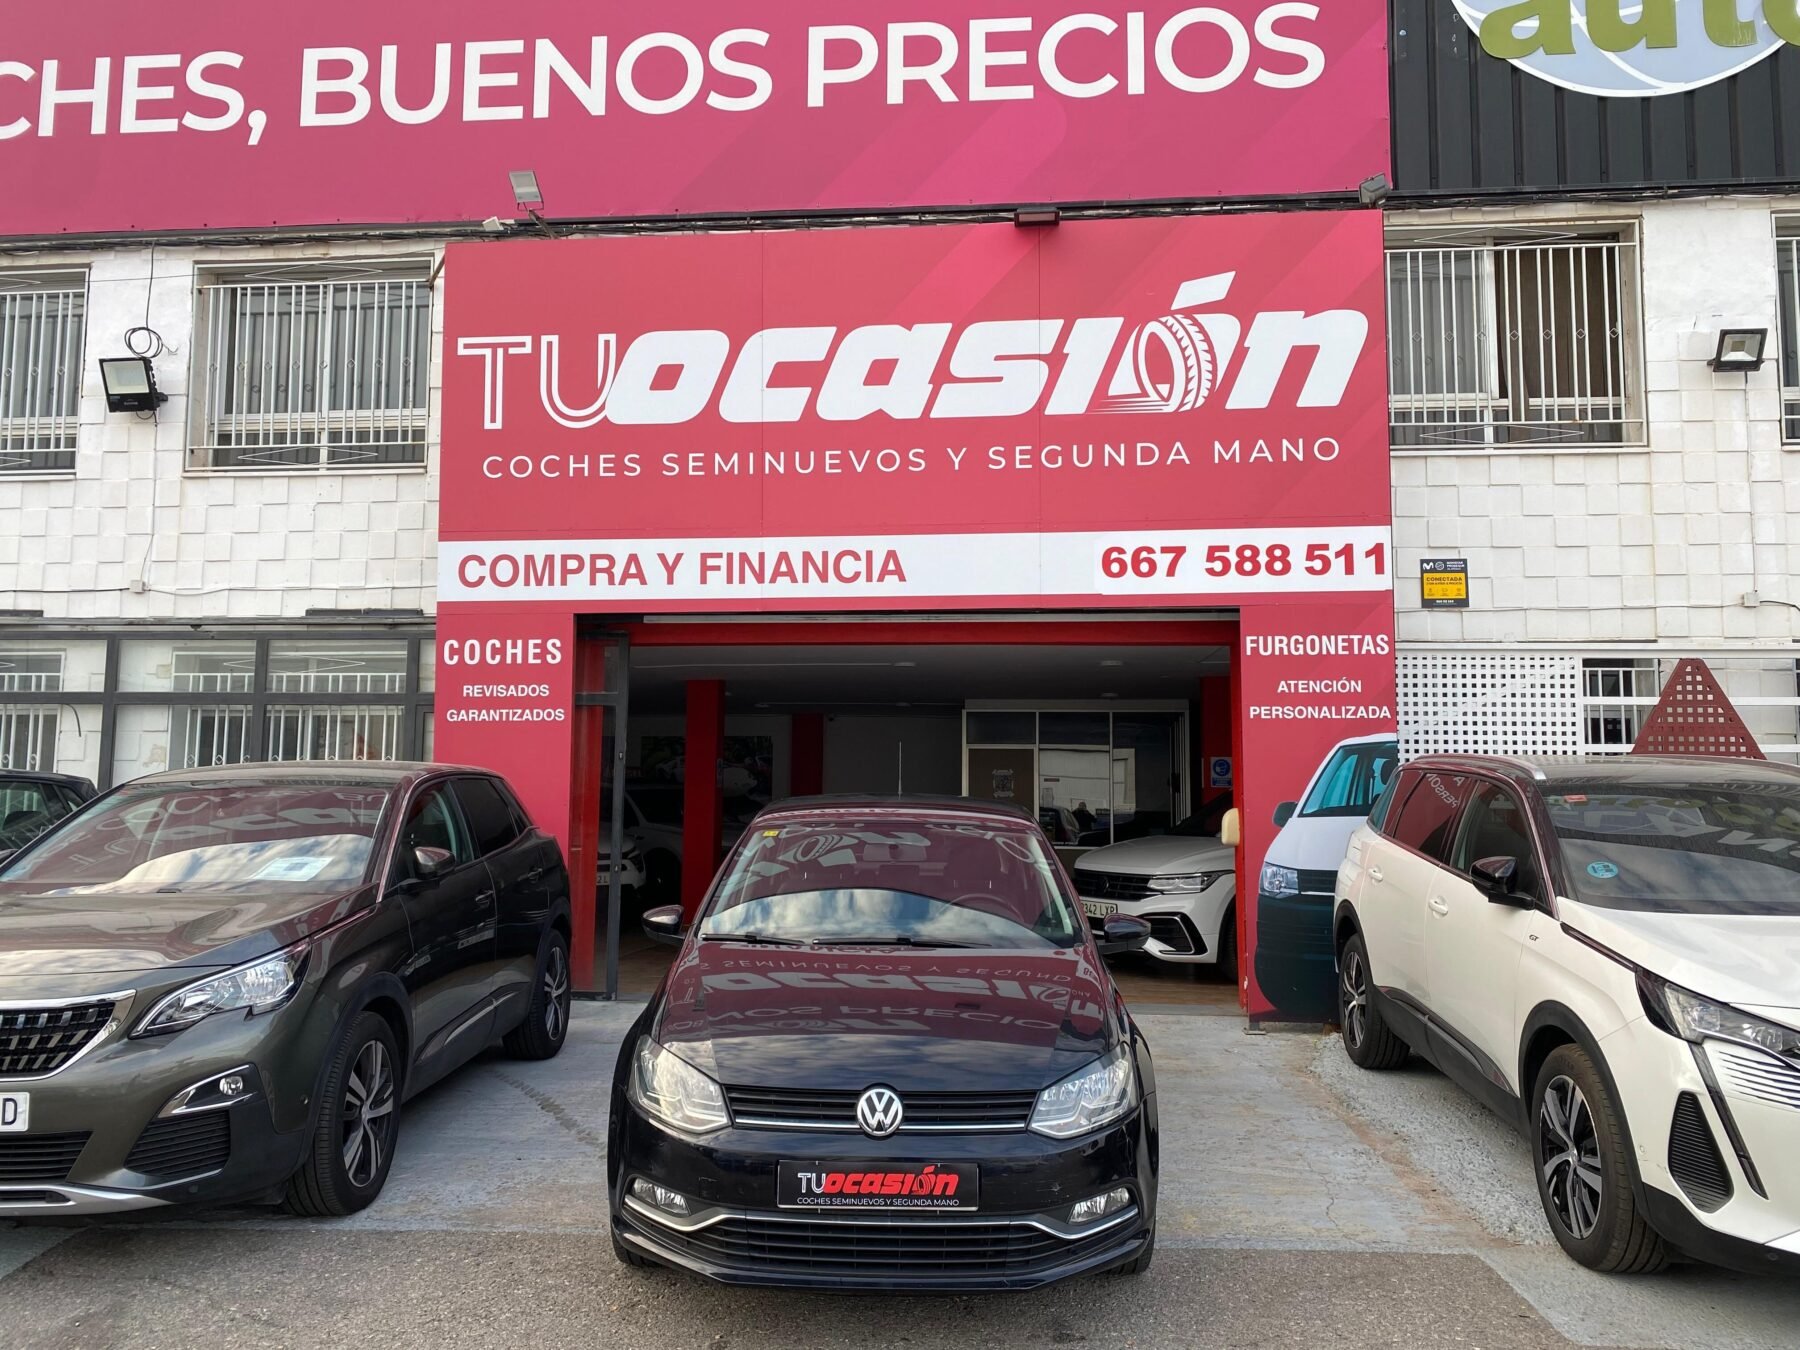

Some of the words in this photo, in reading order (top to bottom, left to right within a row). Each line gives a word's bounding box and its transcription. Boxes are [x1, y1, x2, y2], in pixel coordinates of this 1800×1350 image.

[300, 31, 773, 127] BUENOS
[807, 1, 1326, 108] PRECIOS
[482, 453, 642, 479] COCHES
[662, 448, 926, 476] SEMINUEVOS
[946, 447, 967, 471] Y
[988, 441, 1191, 470] SEGUNDA
[1214, 437, 1340, 464] MANO
[458, 553, 648, 588] COMPRA
[658, 552, 684, 586] Y
[699, 549, 907, 585] FINANCIA
[1101, 545, 1187, 578] 667
[1205, 544, 1292, 577] 588
[1304, 543, 1385, 576] 511
[443, 638, 562, 665] COCHES
[1245, 634, 1390, 656] FURGONETAS
[463, 684, 550, 697] REVISADOS
[1277, 677, 1362, 693] ATENCIÓN
[446, 708, 565, 722] GARANTIZADOS
[1249, 705, 1391, 719] PERSONALIZADA
[796, 1197, 830, 1205] COCHES
[831, 1197, 885, 1206] SEMINUEVOS
[886, 1198, 892, 1206] Y
[892, 1198, 933, 1207] SEGUNDA
[933, 1199, 960, 1207] MANO
